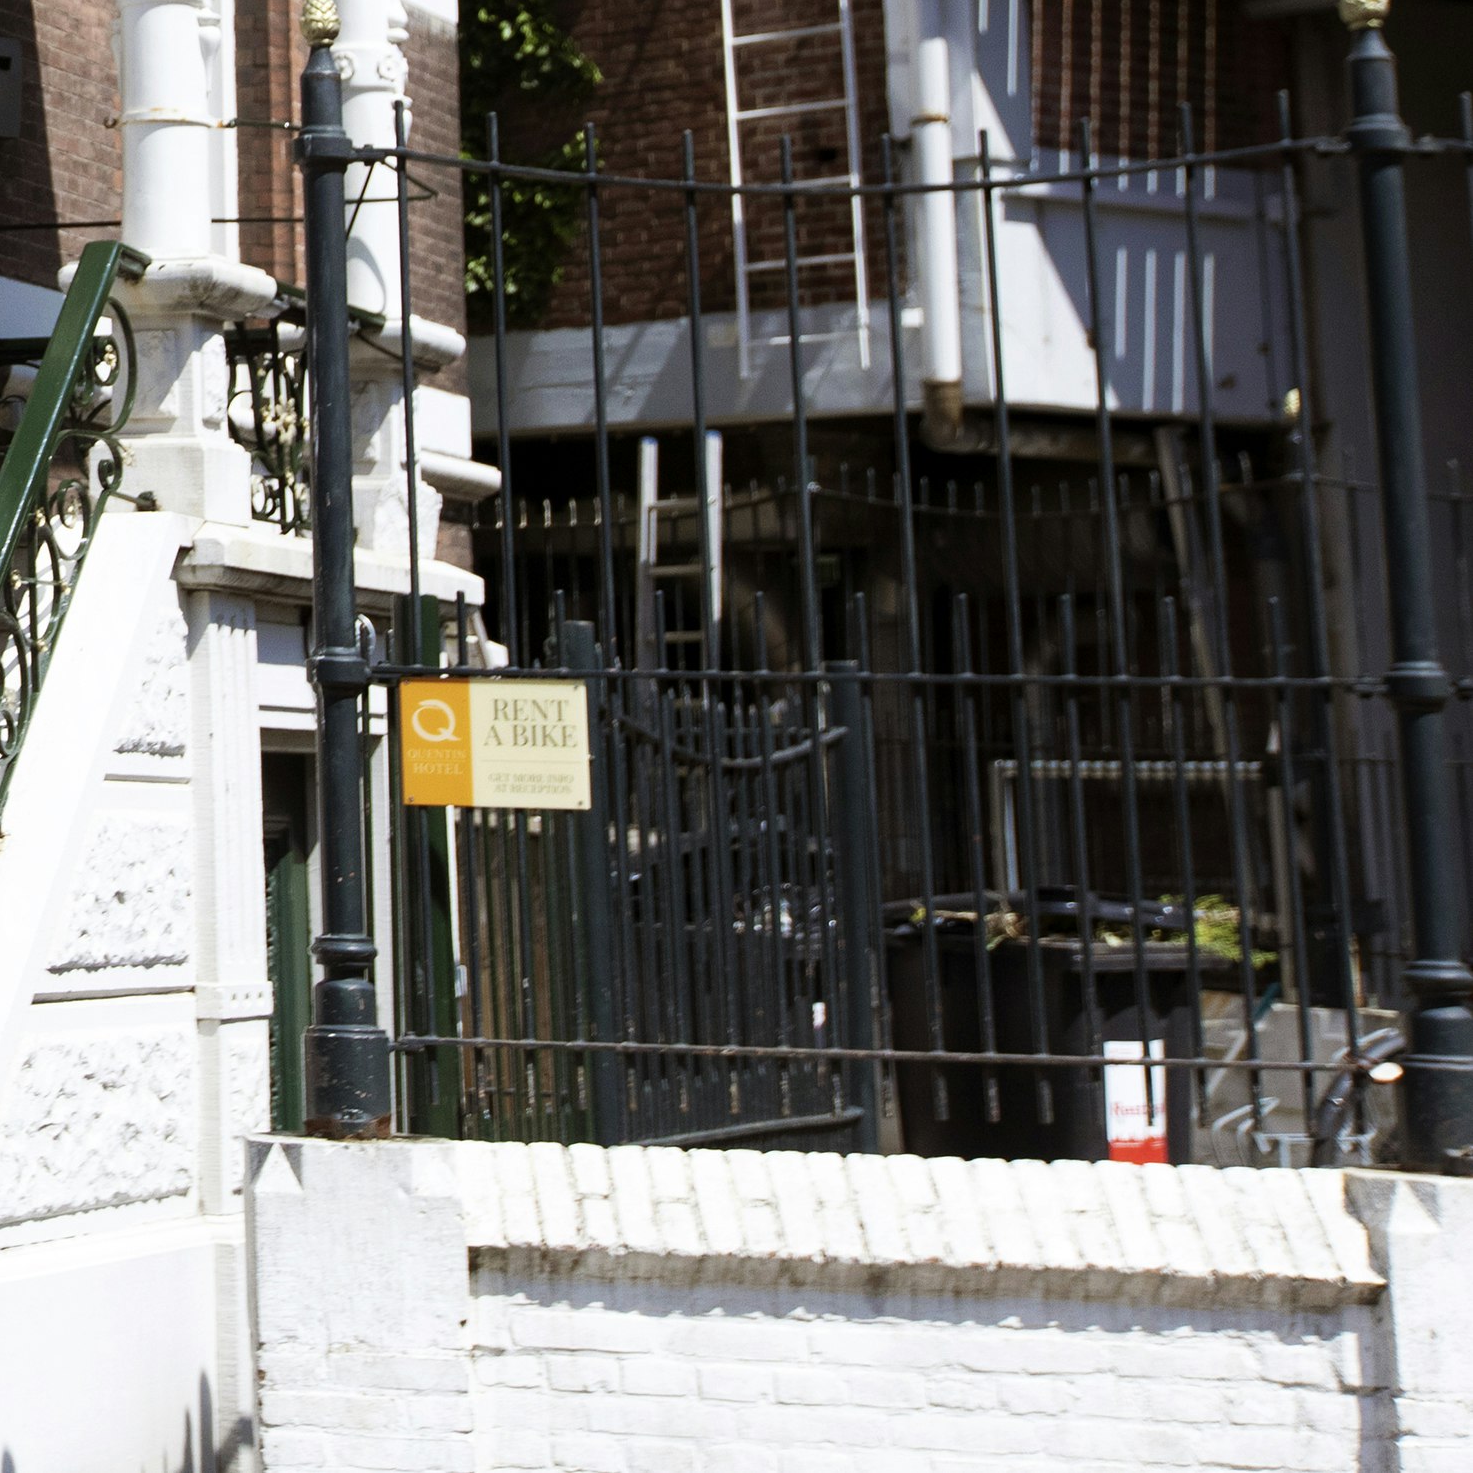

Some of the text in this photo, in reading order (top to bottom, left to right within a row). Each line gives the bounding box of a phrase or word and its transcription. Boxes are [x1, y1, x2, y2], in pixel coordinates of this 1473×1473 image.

[411, 699, 462, 743] Q
[492, 698, 570, 723] RENT
[483, 725, 578, 748] A BIKE
[407, 748, 467, 760] QUENTIN
[412, 762, 464, 776] HOTEL
